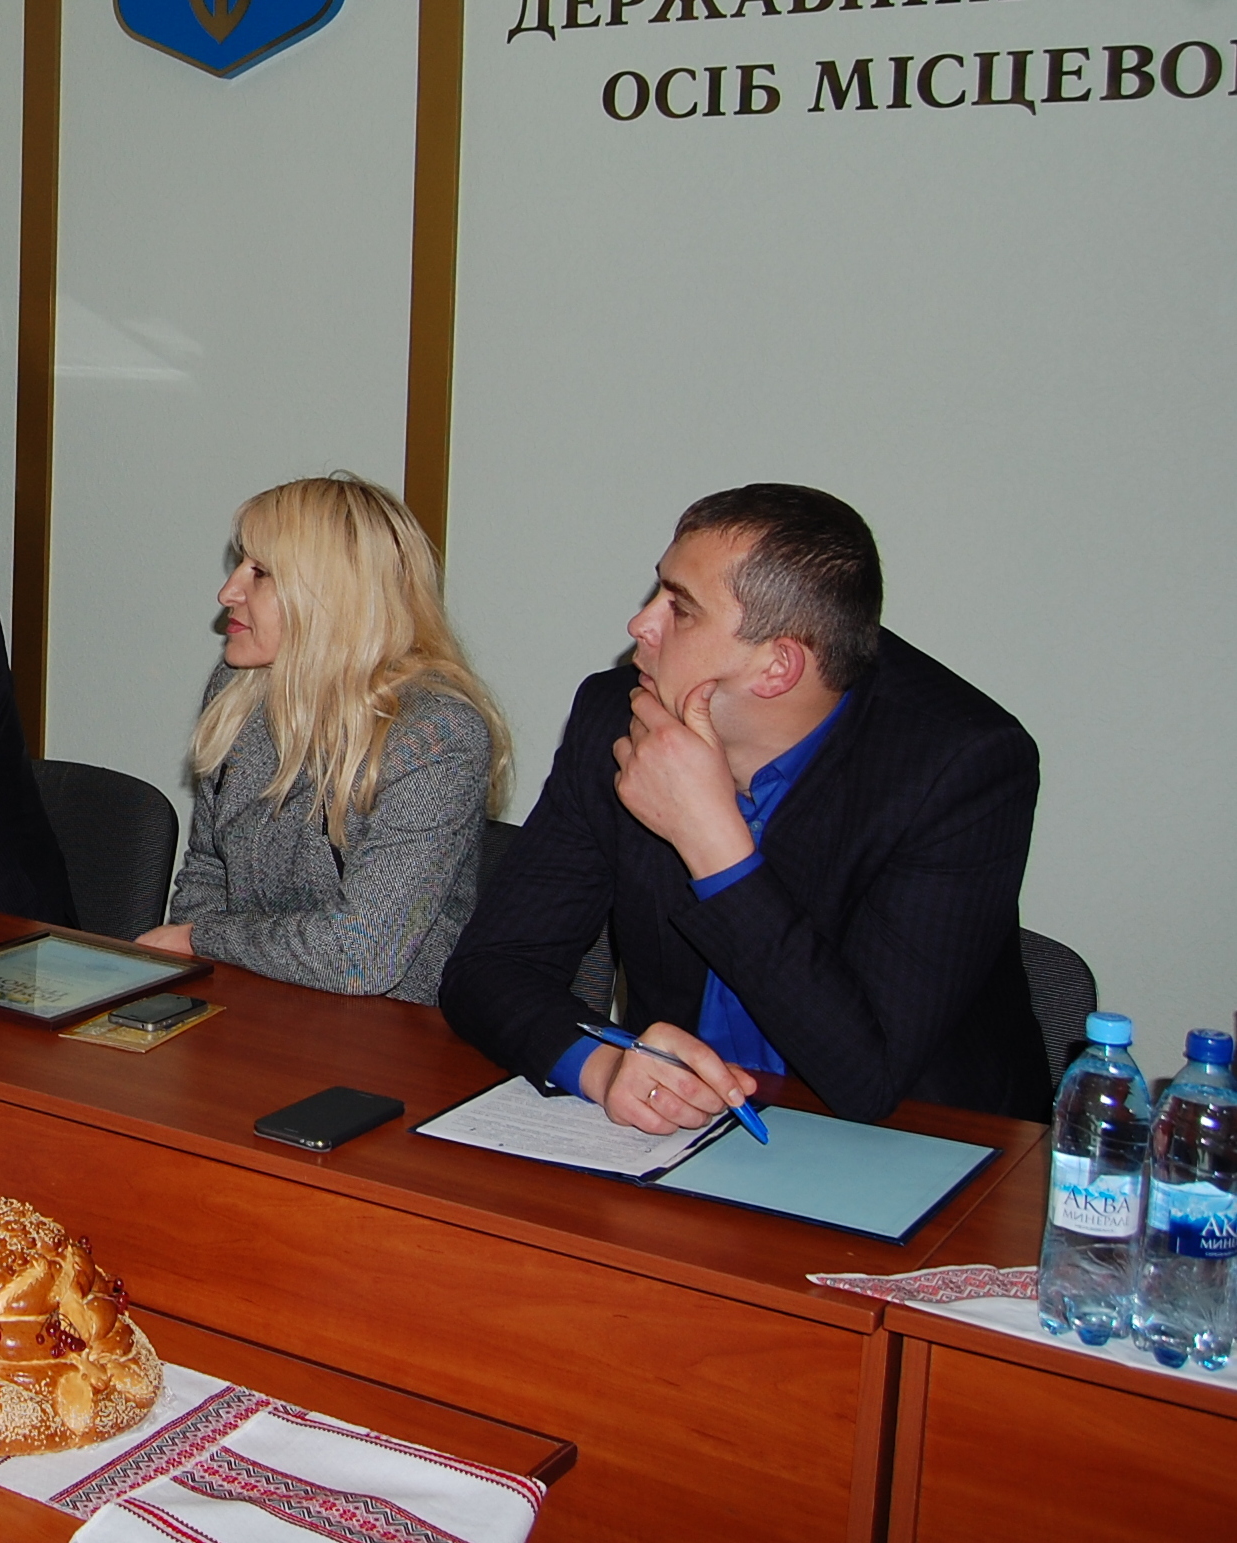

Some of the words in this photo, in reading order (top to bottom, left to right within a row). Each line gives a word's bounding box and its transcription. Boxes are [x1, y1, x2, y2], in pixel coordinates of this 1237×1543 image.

[601, 63, 782, 121] ОСІБ
[807, 38, 1237, 116] МІСЦЕВО
[1063, 1188, 1131, 1217] АКВА
